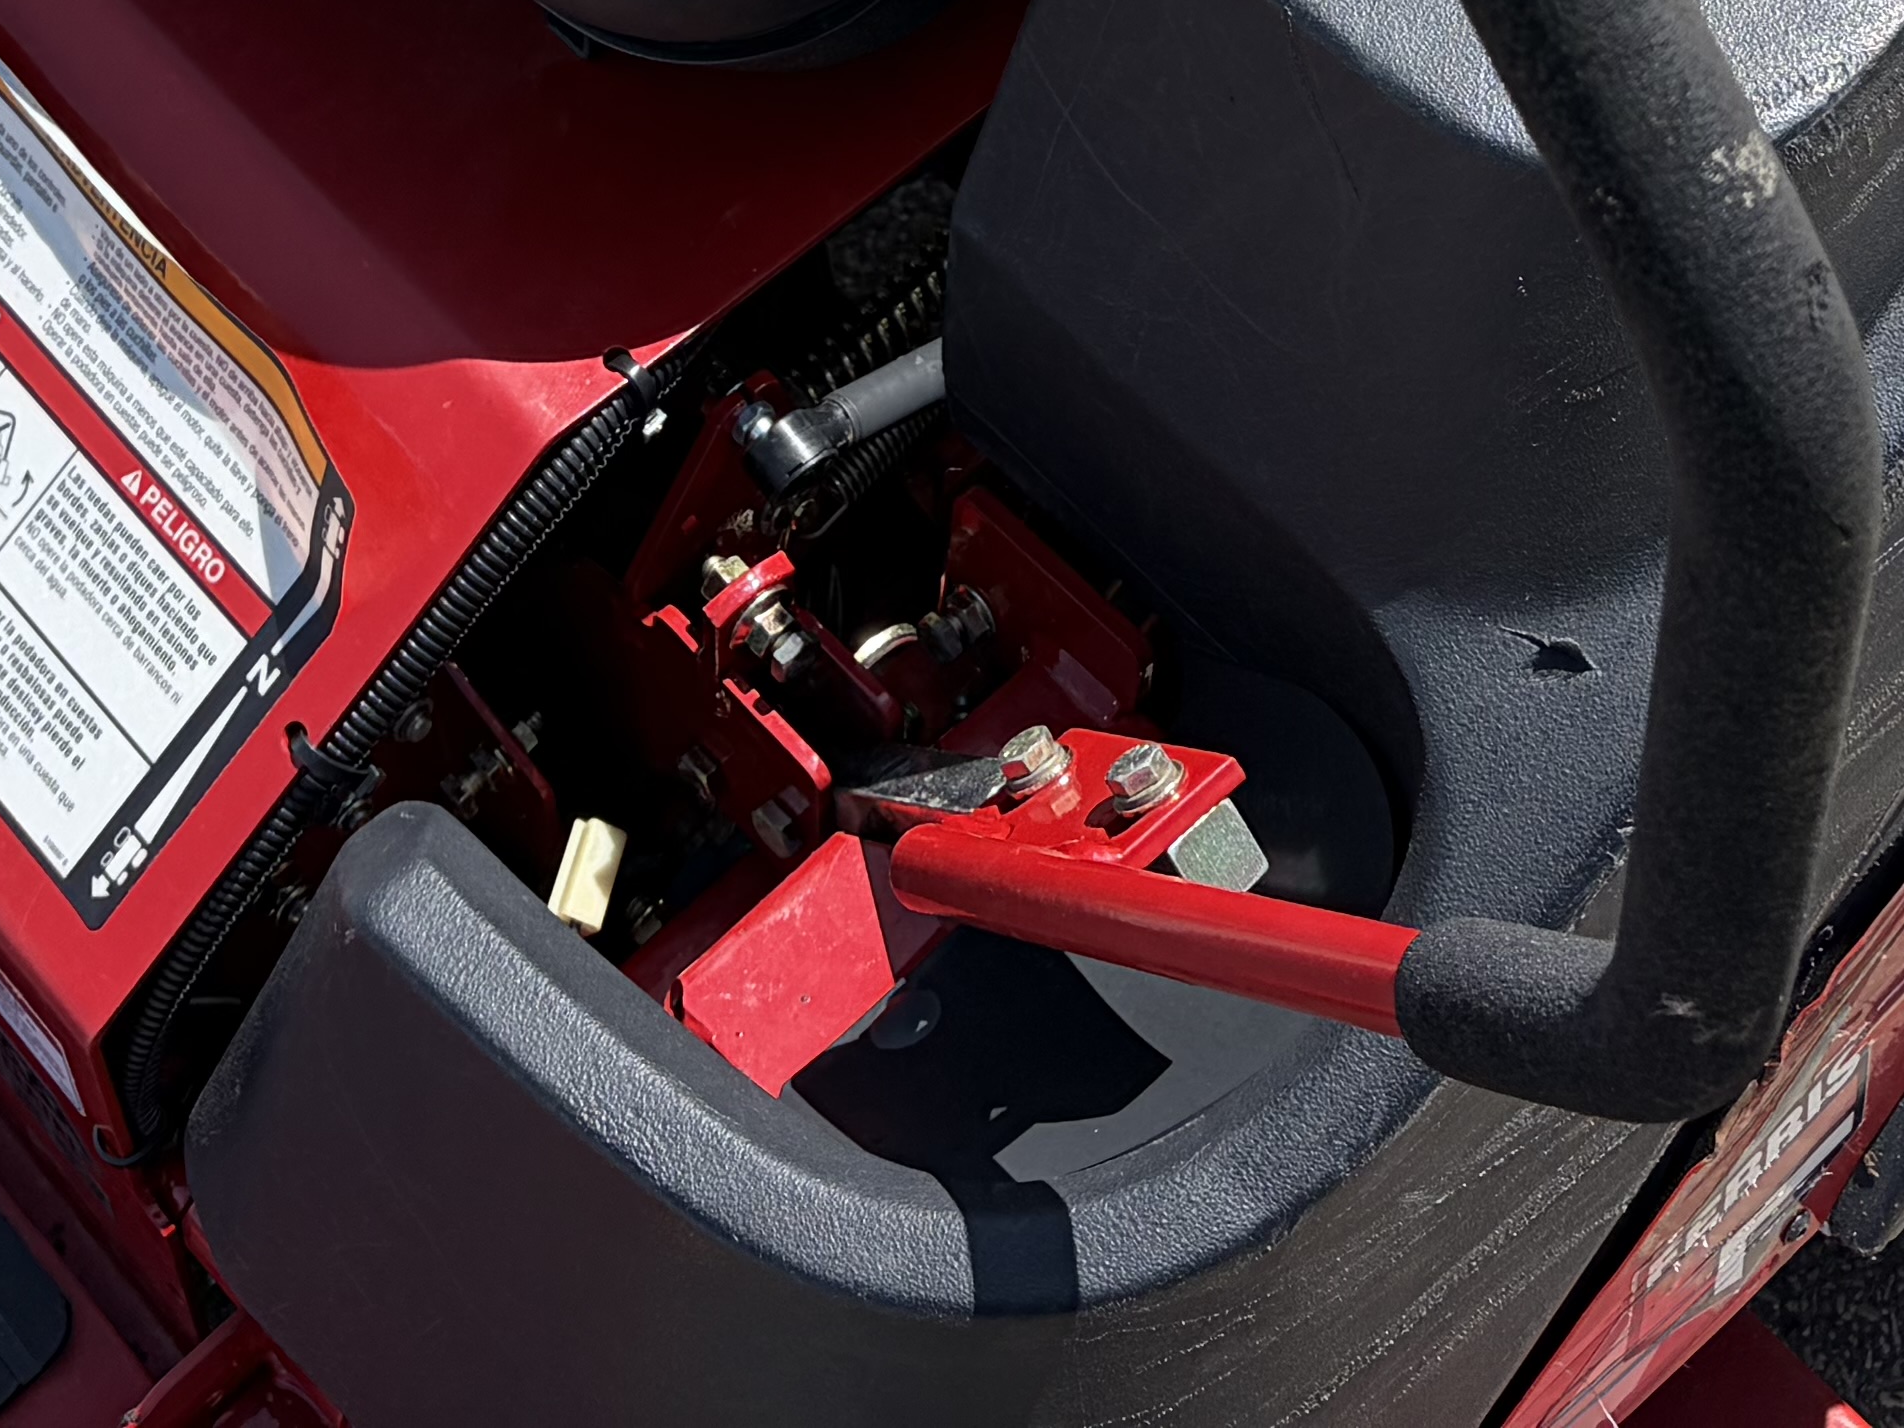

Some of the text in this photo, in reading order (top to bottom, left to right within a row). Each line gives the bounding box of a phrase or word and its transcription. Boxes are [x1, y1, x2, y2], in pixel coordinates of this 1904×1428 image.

[33, 507, 176, 675] graves, la muerte o ahogamiento.
[45, 493, 198, 671] se vuelque y resultando en lesiones
[56, 478, 217, 666] bordes, zanjas o diques haciendo que
[66, 464, 201, 621] Las ruedas pueden caer por los
[139, 484, 224, 582] PELIGRO
[0, 643, 9, 656] o
[6, 652, 56, 711] resbalosas
[51, 707, 83, 744] puede
[2, 618, 15, 637] la
[11, 633, 56, 685] podadora
[53, 681, 68, 700] en
[66, 695, 102, 740] cuestas
[5, 677, 45, 725] deslicey
[39, 720, 73, 758] pierde
[71, 754, 85, 771] el
[246, 653, 280, 696] N
[1646, 1048, 1863, 1289] FERRIS
